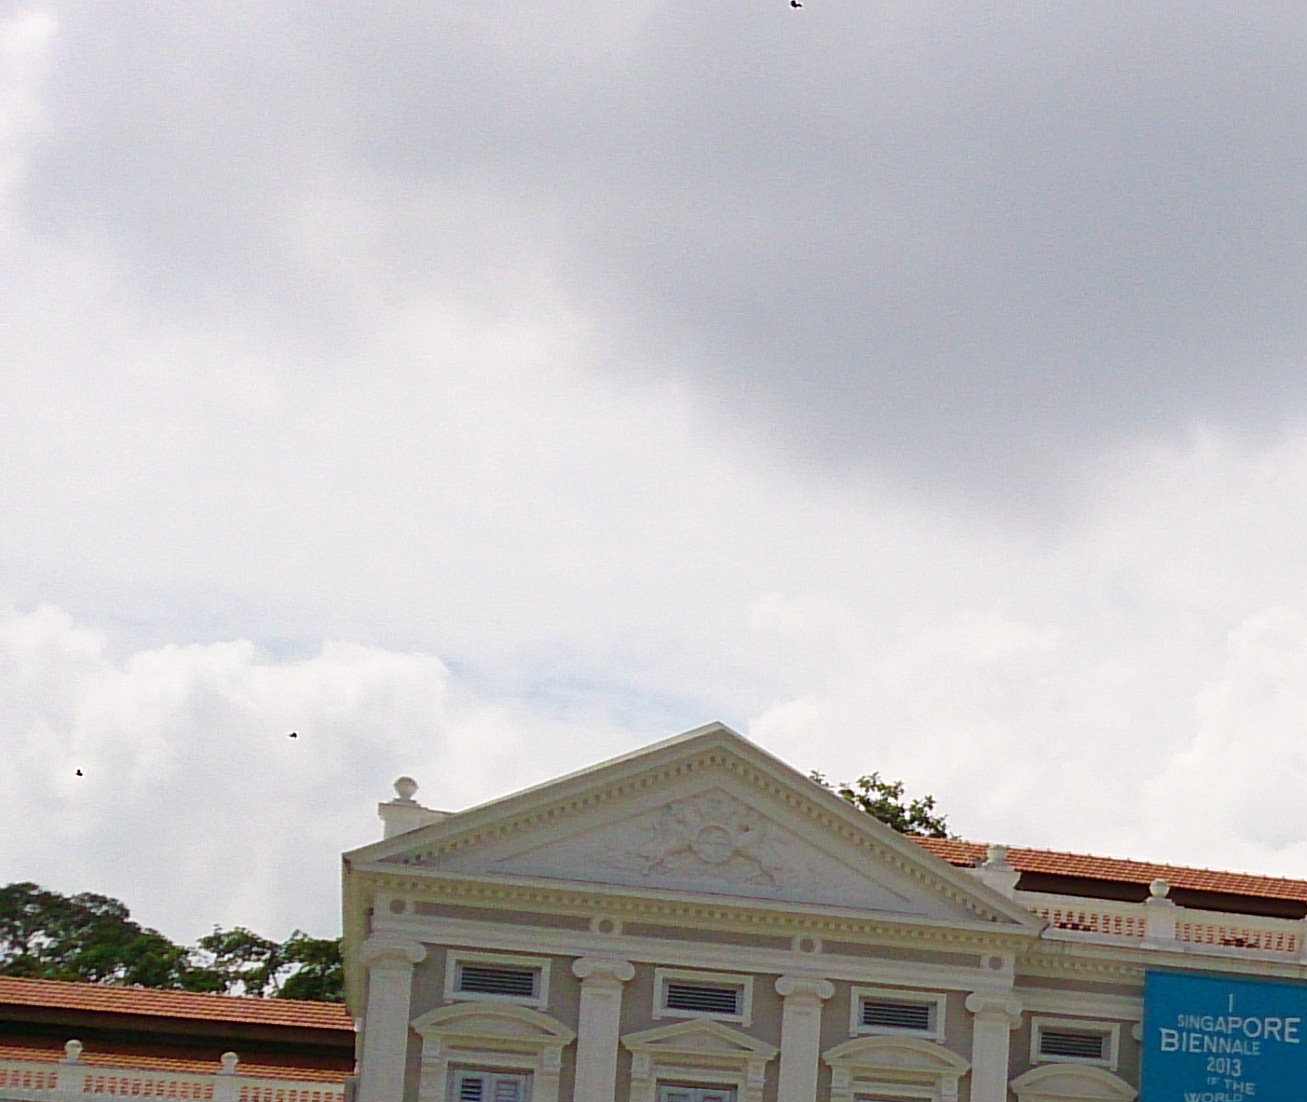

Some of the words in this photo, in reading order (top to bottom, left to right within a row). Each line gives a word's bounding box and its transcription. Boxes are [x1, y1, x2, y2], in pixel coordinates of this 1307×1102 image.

[1177, 1014, 1301, 1043] SINGAPORE
[1159, 1027, 1261, 1056] BIENNALE
[1206, 1056, 1242, 1077] 2013
[1207, 1076, 1219, 1086] IF
[1224, 1078, 1256, 1095] THE
